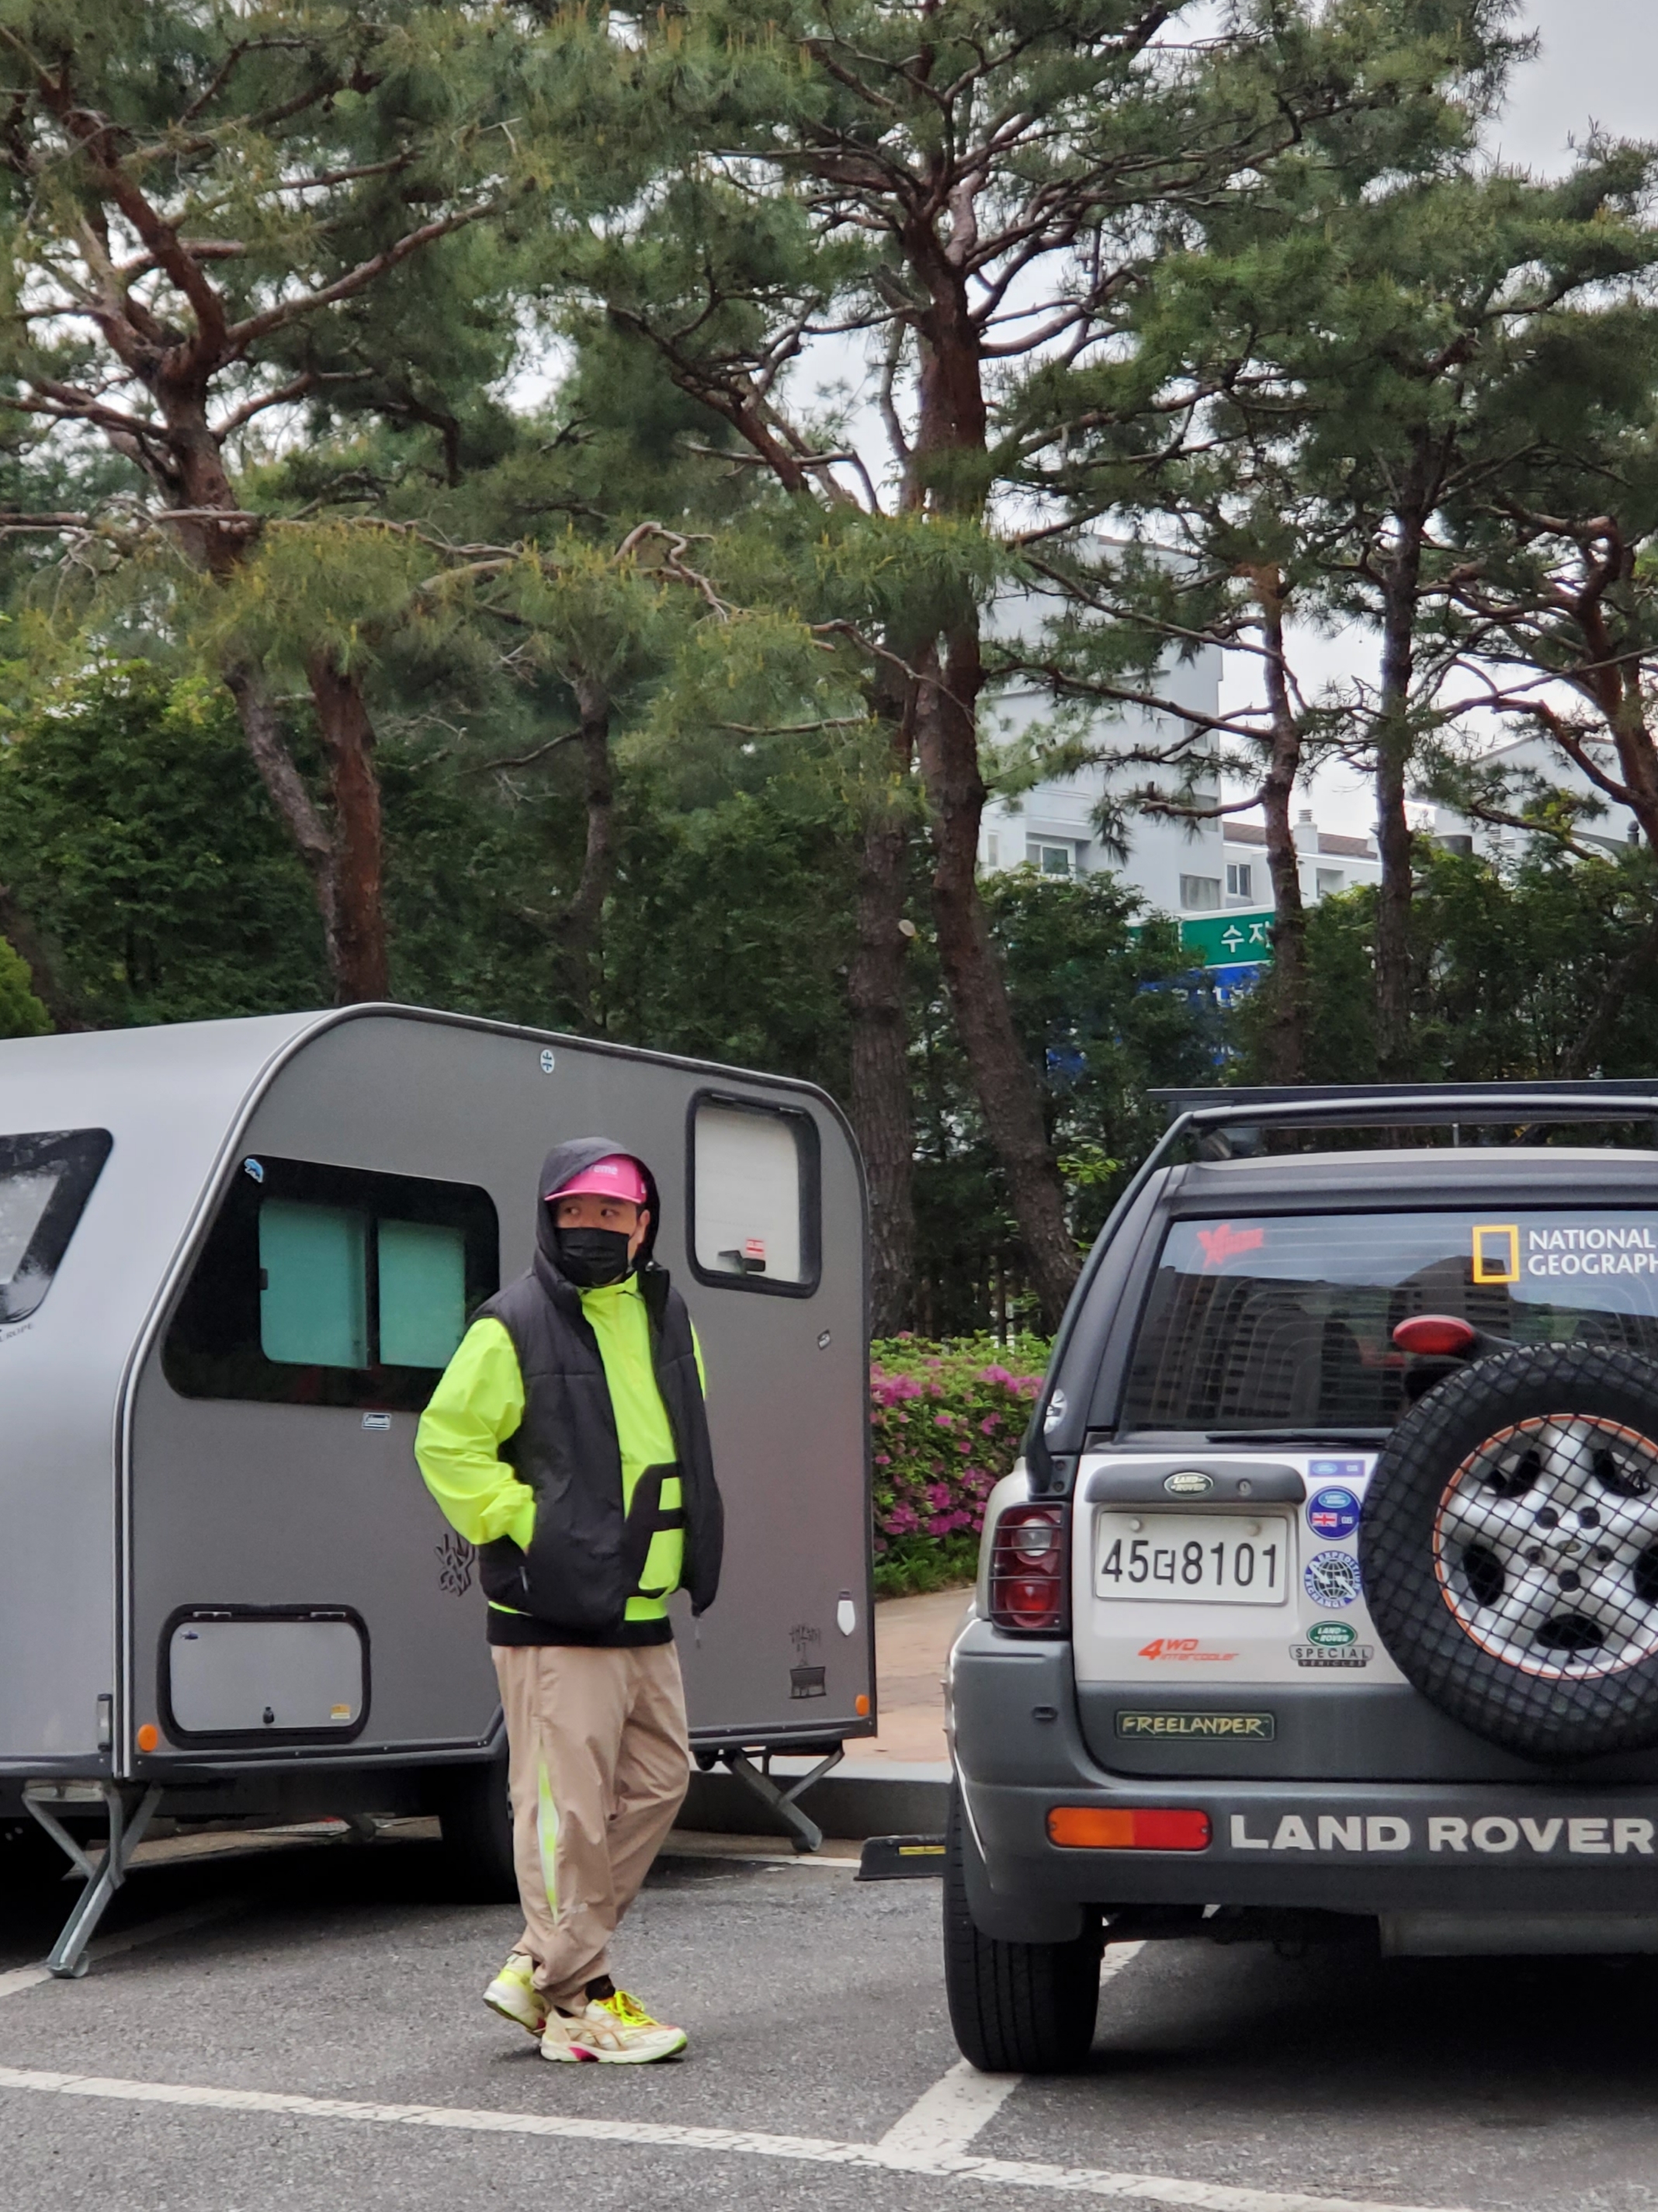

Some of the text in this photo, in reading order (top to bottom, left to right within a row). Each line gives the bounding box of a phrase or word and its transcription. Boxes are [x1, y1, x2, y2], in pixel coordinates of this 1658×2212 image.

[1528, 1228, 1656, 1250] NATIONAL
[1101, 1539, 1276, 1588] 45더8101
[1317, 1552, 1361, 1590] EXPEDITION
[1305, 1573, 1347, 1608] EXCHANGE
[1138, 1638, 1199, 1661] 4WD
[1296, 1648, 1369, 1659] SPECIAL
[1122, 1716, 1265, 1737] FREELANDER
[1230, 1815, 1655, 1854] LAND ROVER
